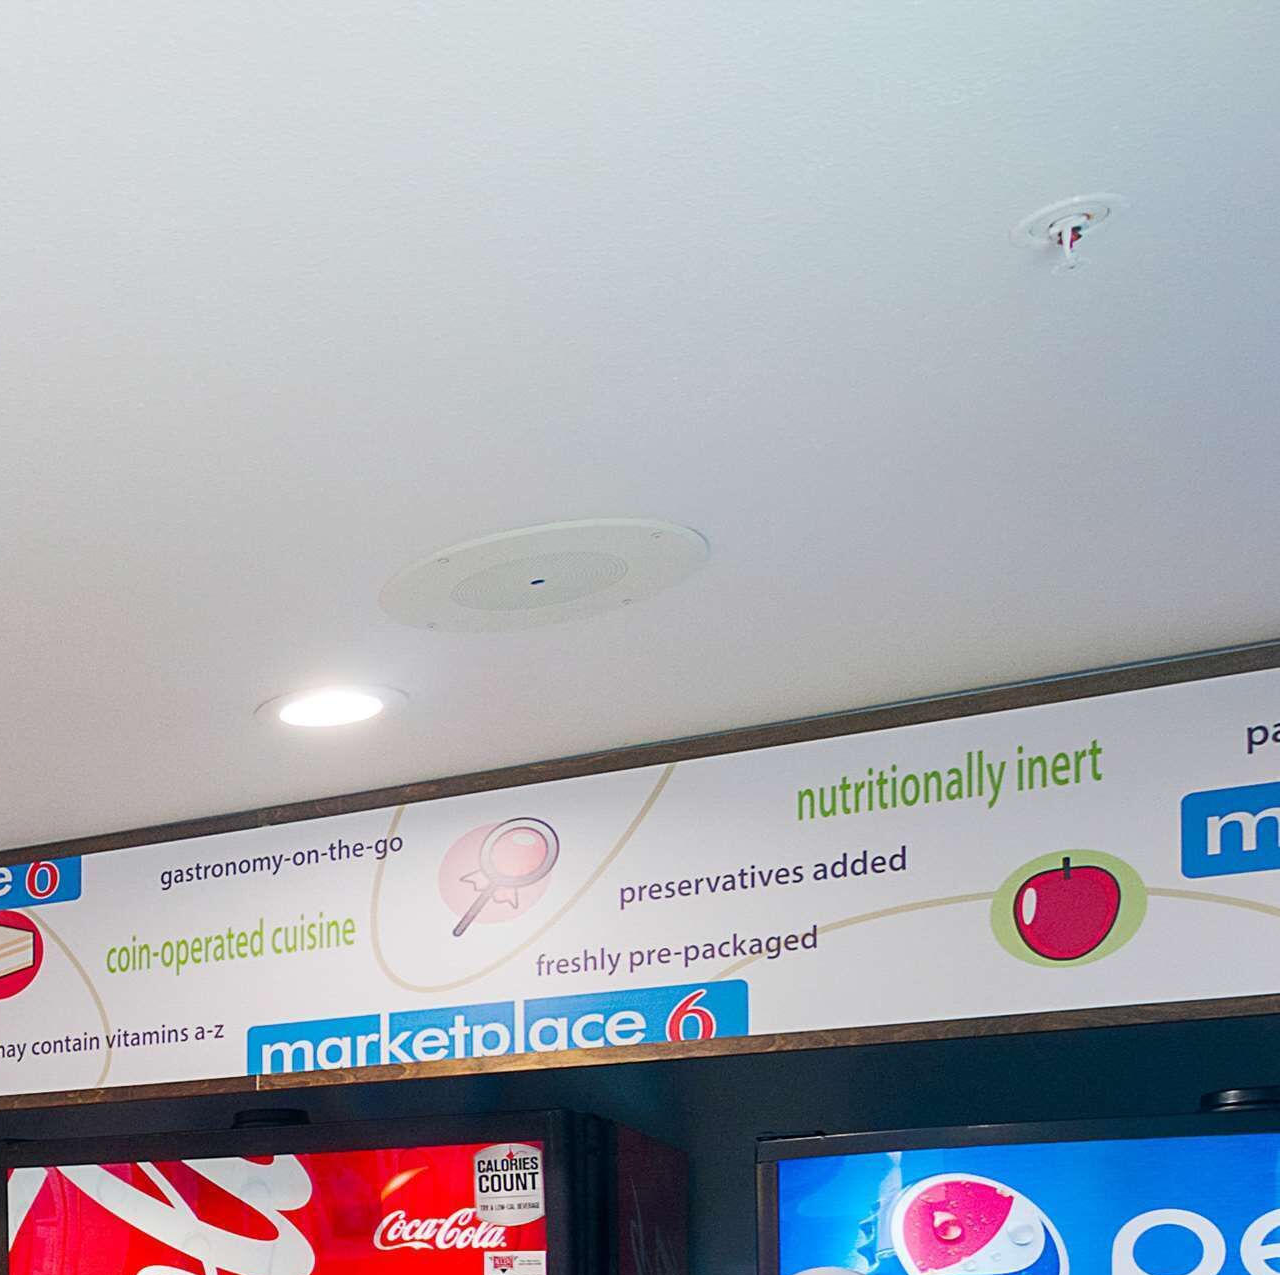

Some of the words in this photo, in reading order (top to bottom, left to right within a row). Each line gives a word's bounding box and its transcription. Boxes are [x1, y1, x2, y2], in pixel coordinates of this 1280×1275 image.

[797, 752, 1006, 821] nutritionally
[1017, 739, 1103, 792] inert
[160, 833, 404, 891] gastronomy-on-the-go
[619, 860, 804, 906] preservatives
[813, 846, 907, 882] added
[106, 918, 265, 976] coin-operated
[270, 912, 356, 954] cuisine
[536, 949, 620, 978] freshly
[628, 925, 818, 974] pre-packaged
[31, 1030, 100, 1057] contain
[106, 1023, 188, 1049] vitamins
[194, 1022, 224, 1042] a-z
[262, 1001, 645, 1074] marketplace
[665, 988, 716, 1043] 6
[477, 1156, 538, 1173] CALORIES
[479, 1172, 539, 1193] COUNT
